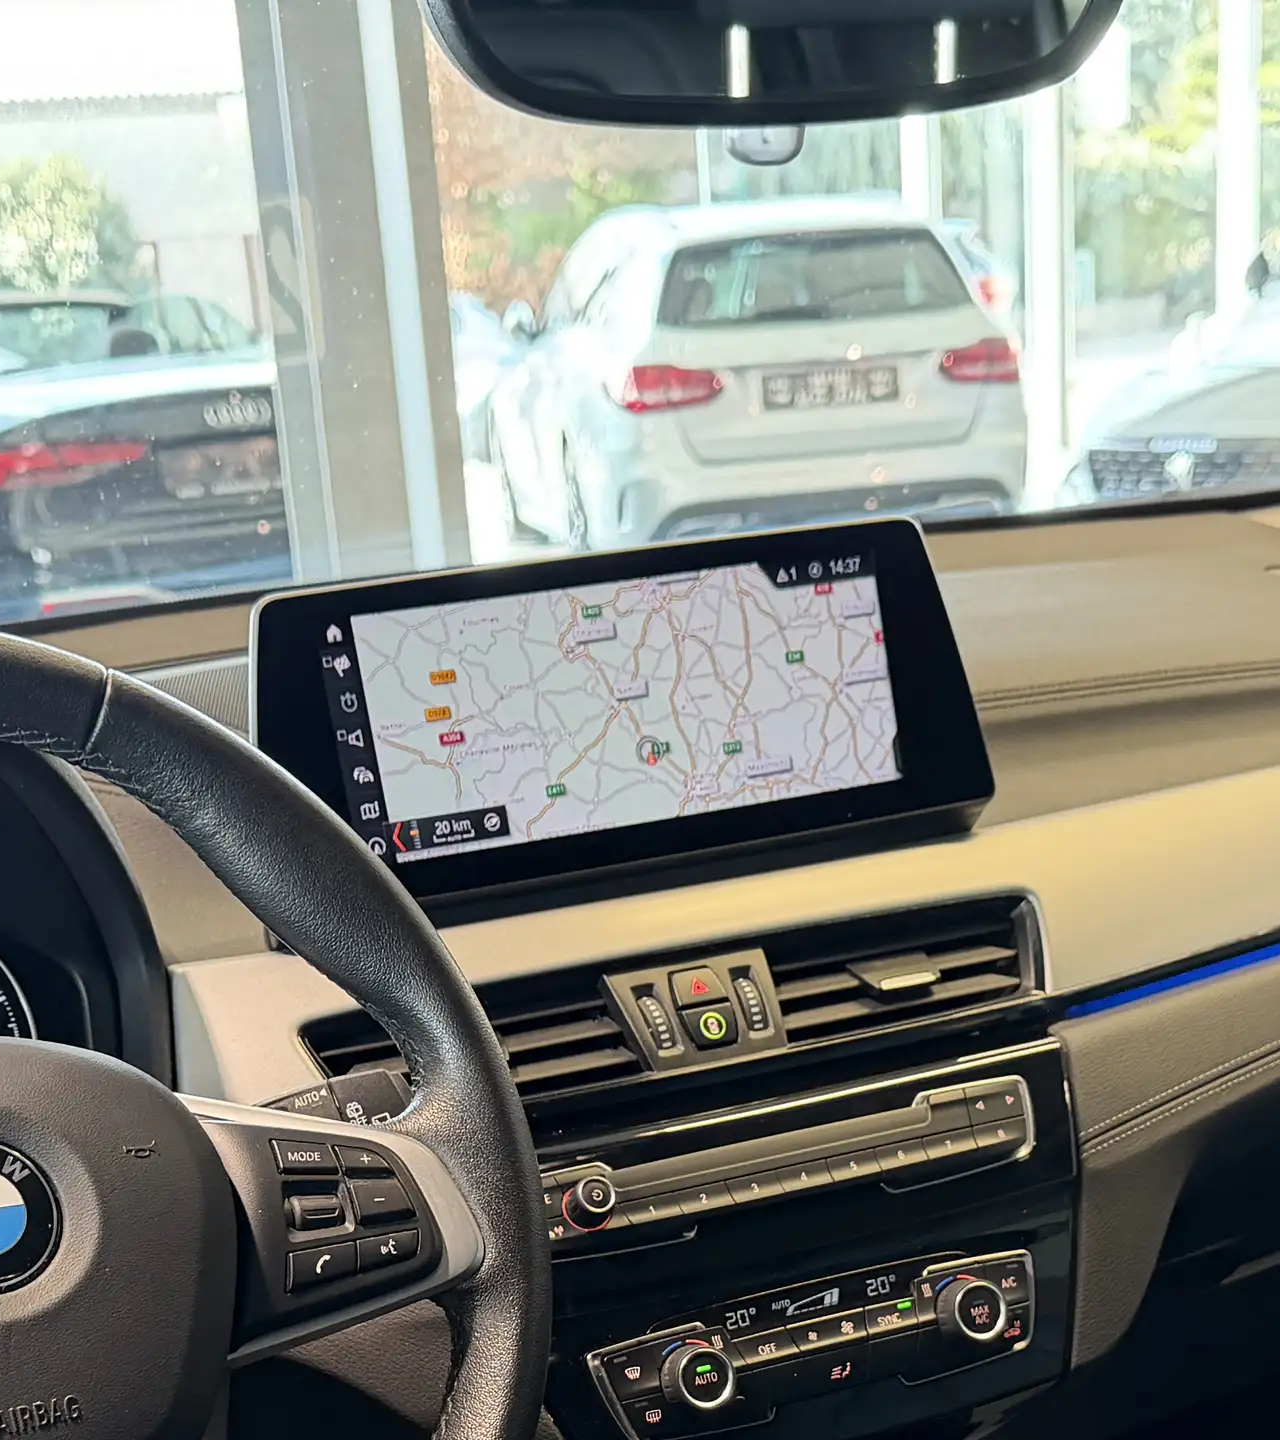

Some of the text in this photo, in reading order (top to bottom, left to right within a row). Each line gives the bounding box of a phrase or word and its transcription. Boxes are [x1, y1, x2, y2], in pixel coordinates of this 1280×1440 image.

[434, 819, 472, 836] 20 km
[294, 1090, 320, 1109] AUTO
[944, 1140, 952, 1150] 7
[287, 1151, 322, 1162] MODE
[897, 1149, 906, 1160] 6
[849, 1160, 857, 1171] 5
[800, 1171, 808, 1182] 4
[751, 1182, 759, 1193] 3
[699, 1193, 708, 1204] 2
[648, 1205, 656, 1215] 1
[771, 1299, 791, 1311] AUTO
[970, 1305, 990, 1317] MAX
[877, 1312, 902, 1326] SYNC
[758, 1342, 777, 1356] OFF
[695, 1371, 718, 1386] AUTO
